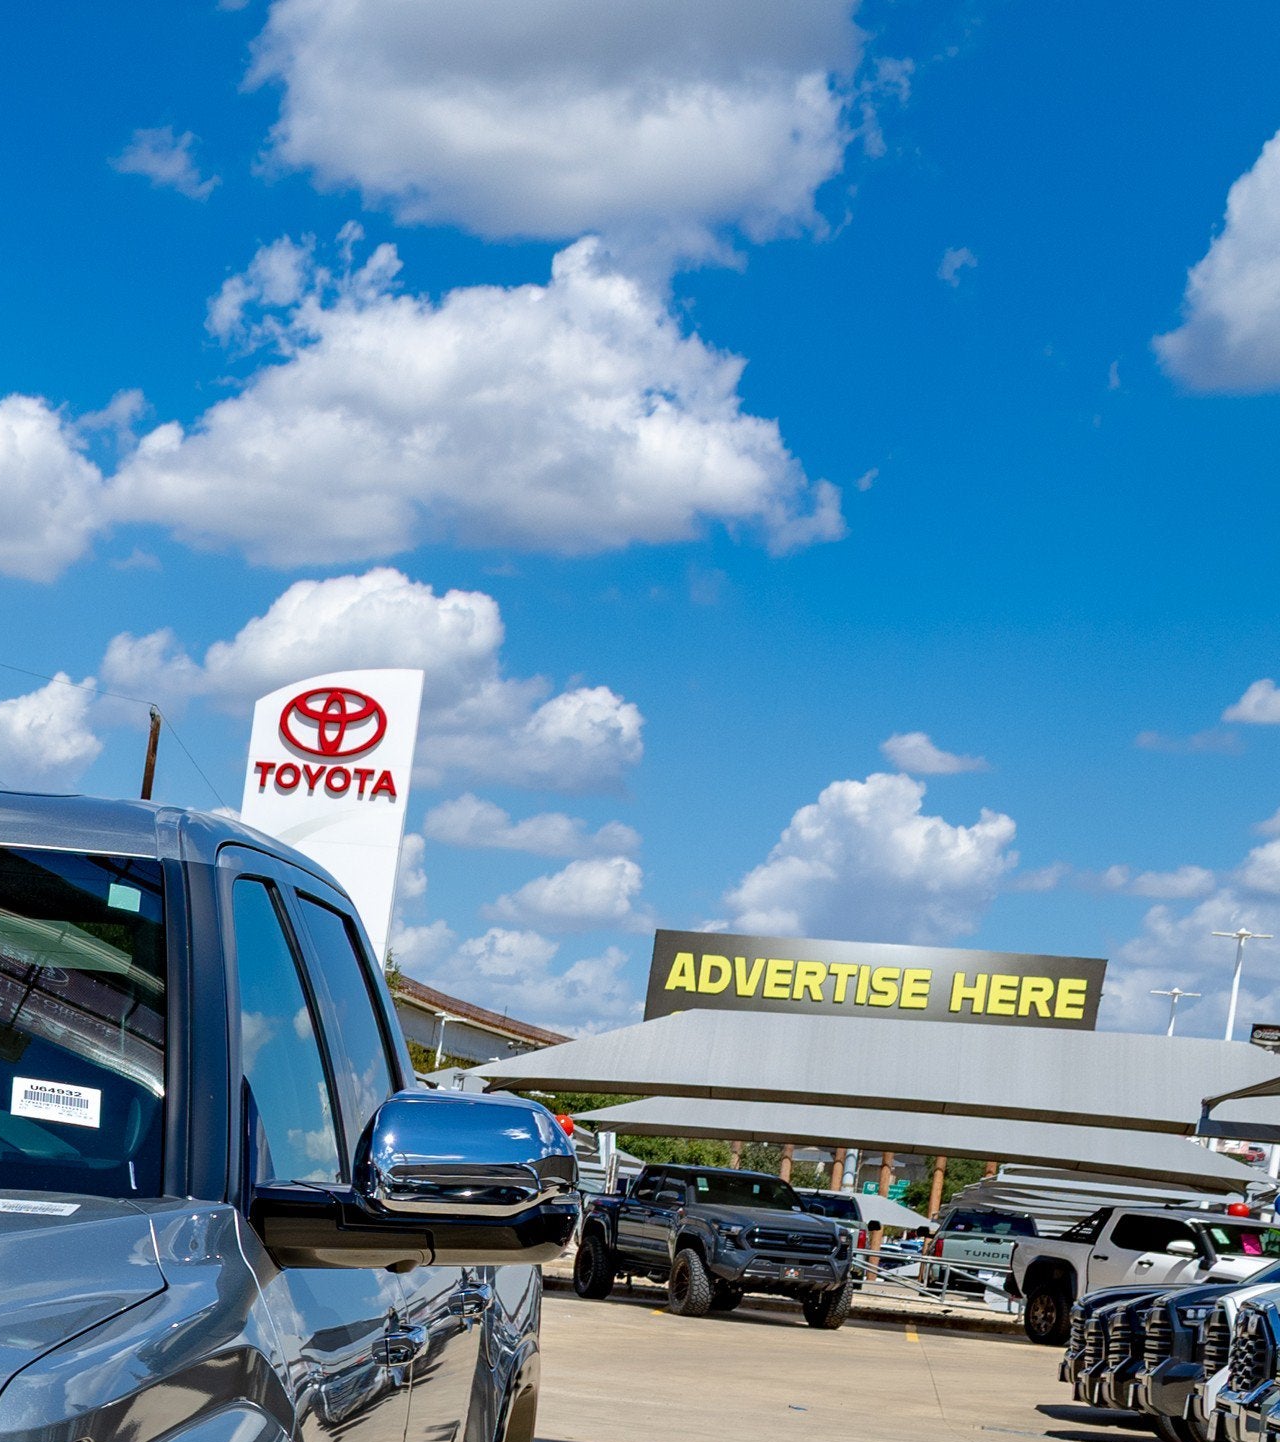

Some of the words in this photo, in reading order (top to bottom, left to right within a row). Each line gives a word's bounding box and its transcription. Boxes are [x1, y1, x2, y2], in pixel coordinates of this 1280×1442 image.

[255, 761, 396, 798] TOYOTA
[664, 952, 932, 1009] ADVERTISE
[949, 972, 1088, 1020] HERE
[964, 1249, 1010, 1260] TUNDR
